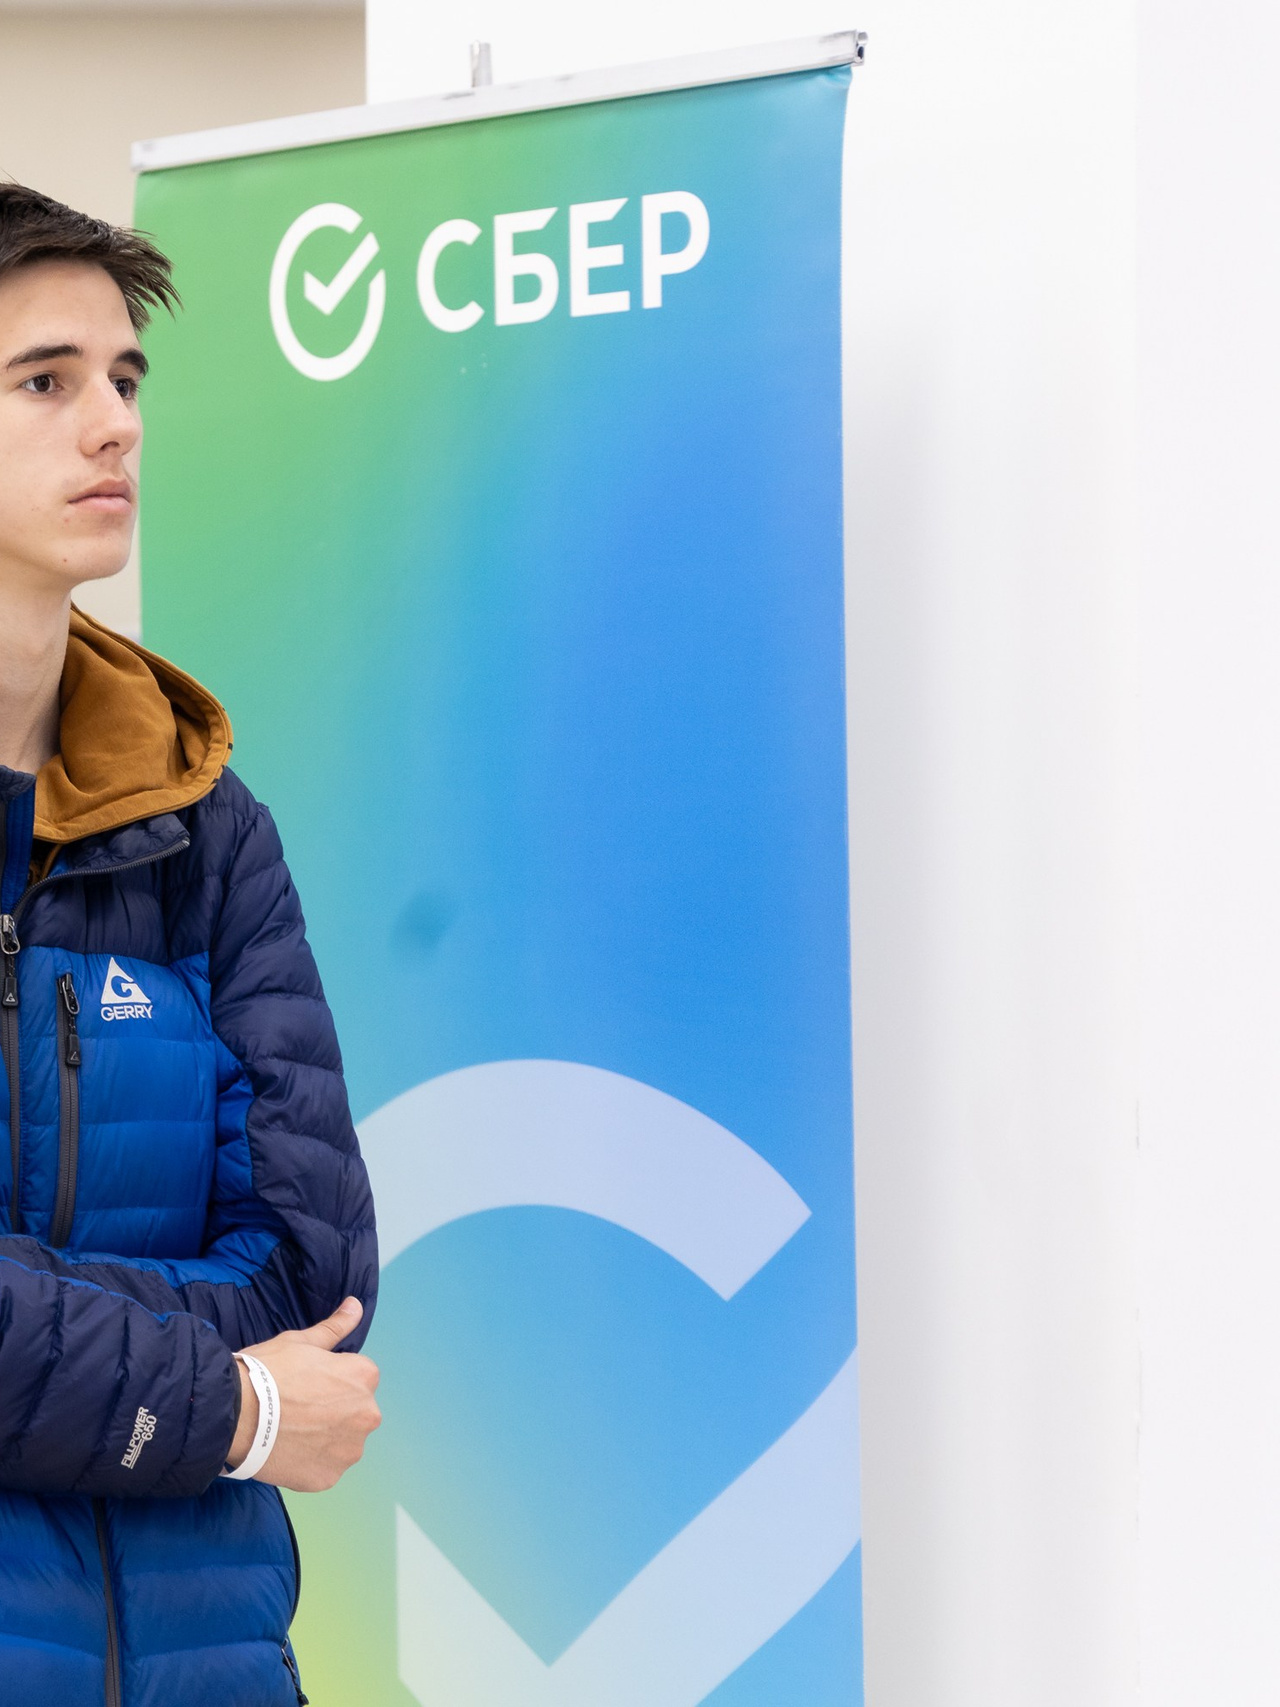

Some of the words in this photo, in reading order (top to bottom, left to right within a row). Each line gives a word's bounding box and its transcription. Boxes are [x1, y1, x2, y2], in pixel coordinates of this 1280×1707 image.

[416, 190, 711, 333] СБЕР
[101, 1005, 153, 1021] GERRY
[121, 1406, 149, 1469] FILLPOWER
[141, 1415, 157, 1441] 650
[261, 1419, 273, 1447] 2024
